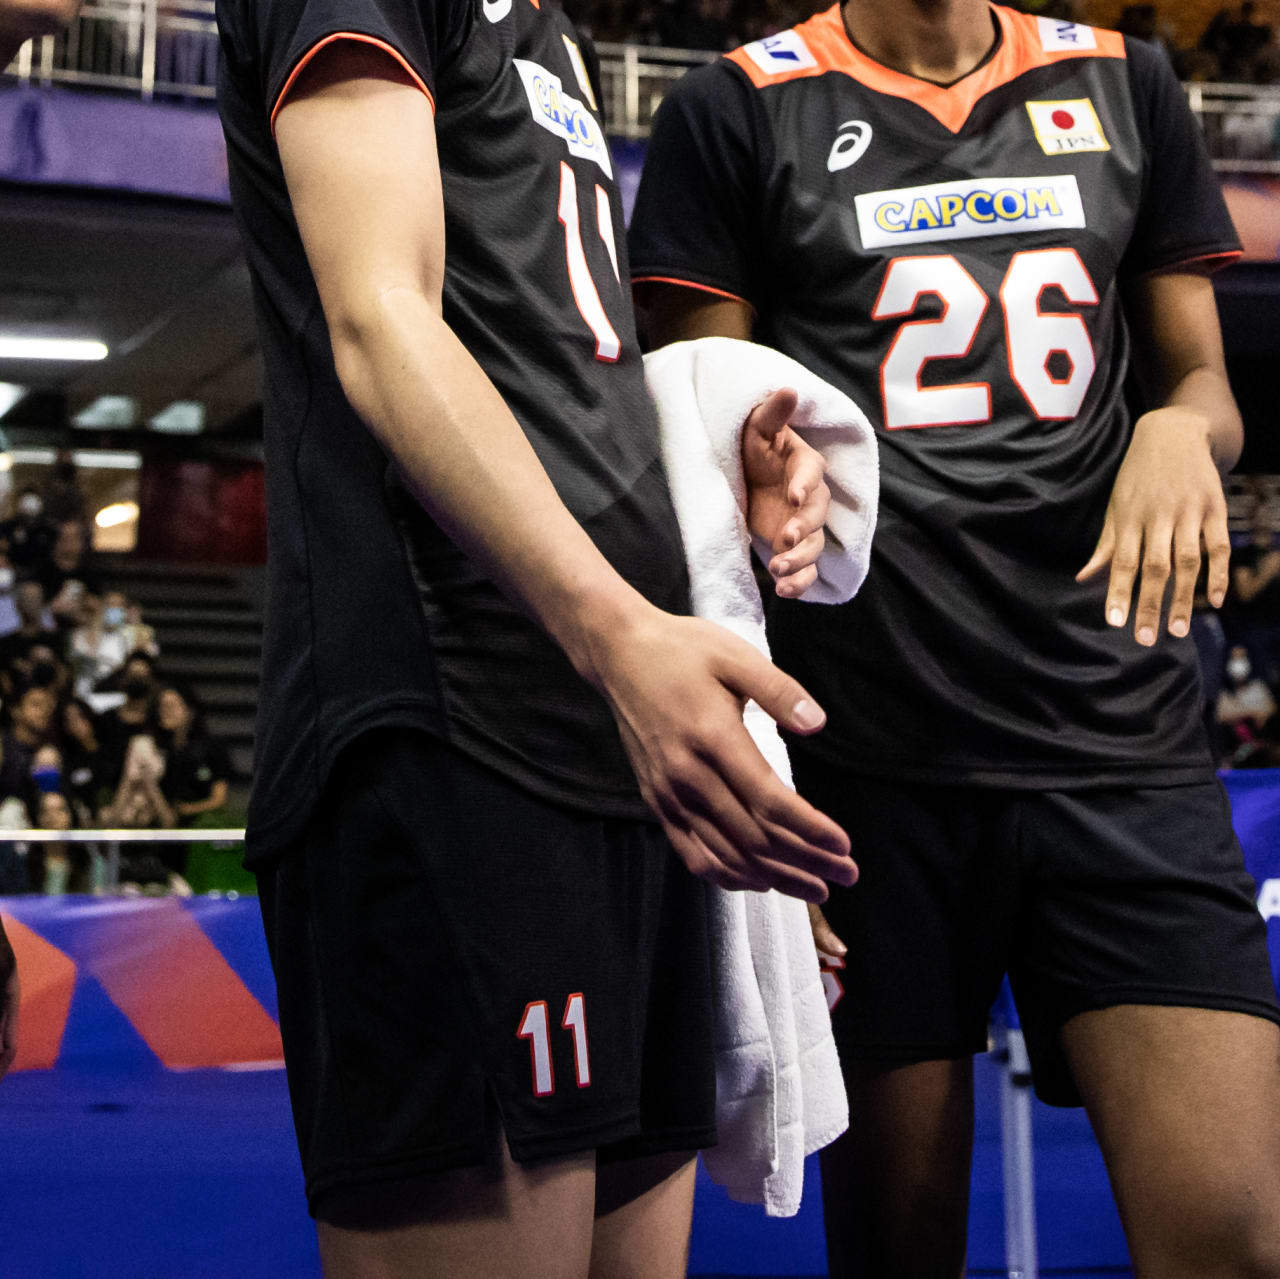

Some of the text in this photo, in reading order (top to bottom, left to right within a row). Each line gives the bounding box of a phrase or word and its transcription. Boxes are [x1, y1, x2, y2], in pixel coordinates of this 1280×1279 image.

[874, 186, 1064, 233] CAPCOM
[871, 246, 1101, 431] 26
[515, 991, 592, 1098] 11
